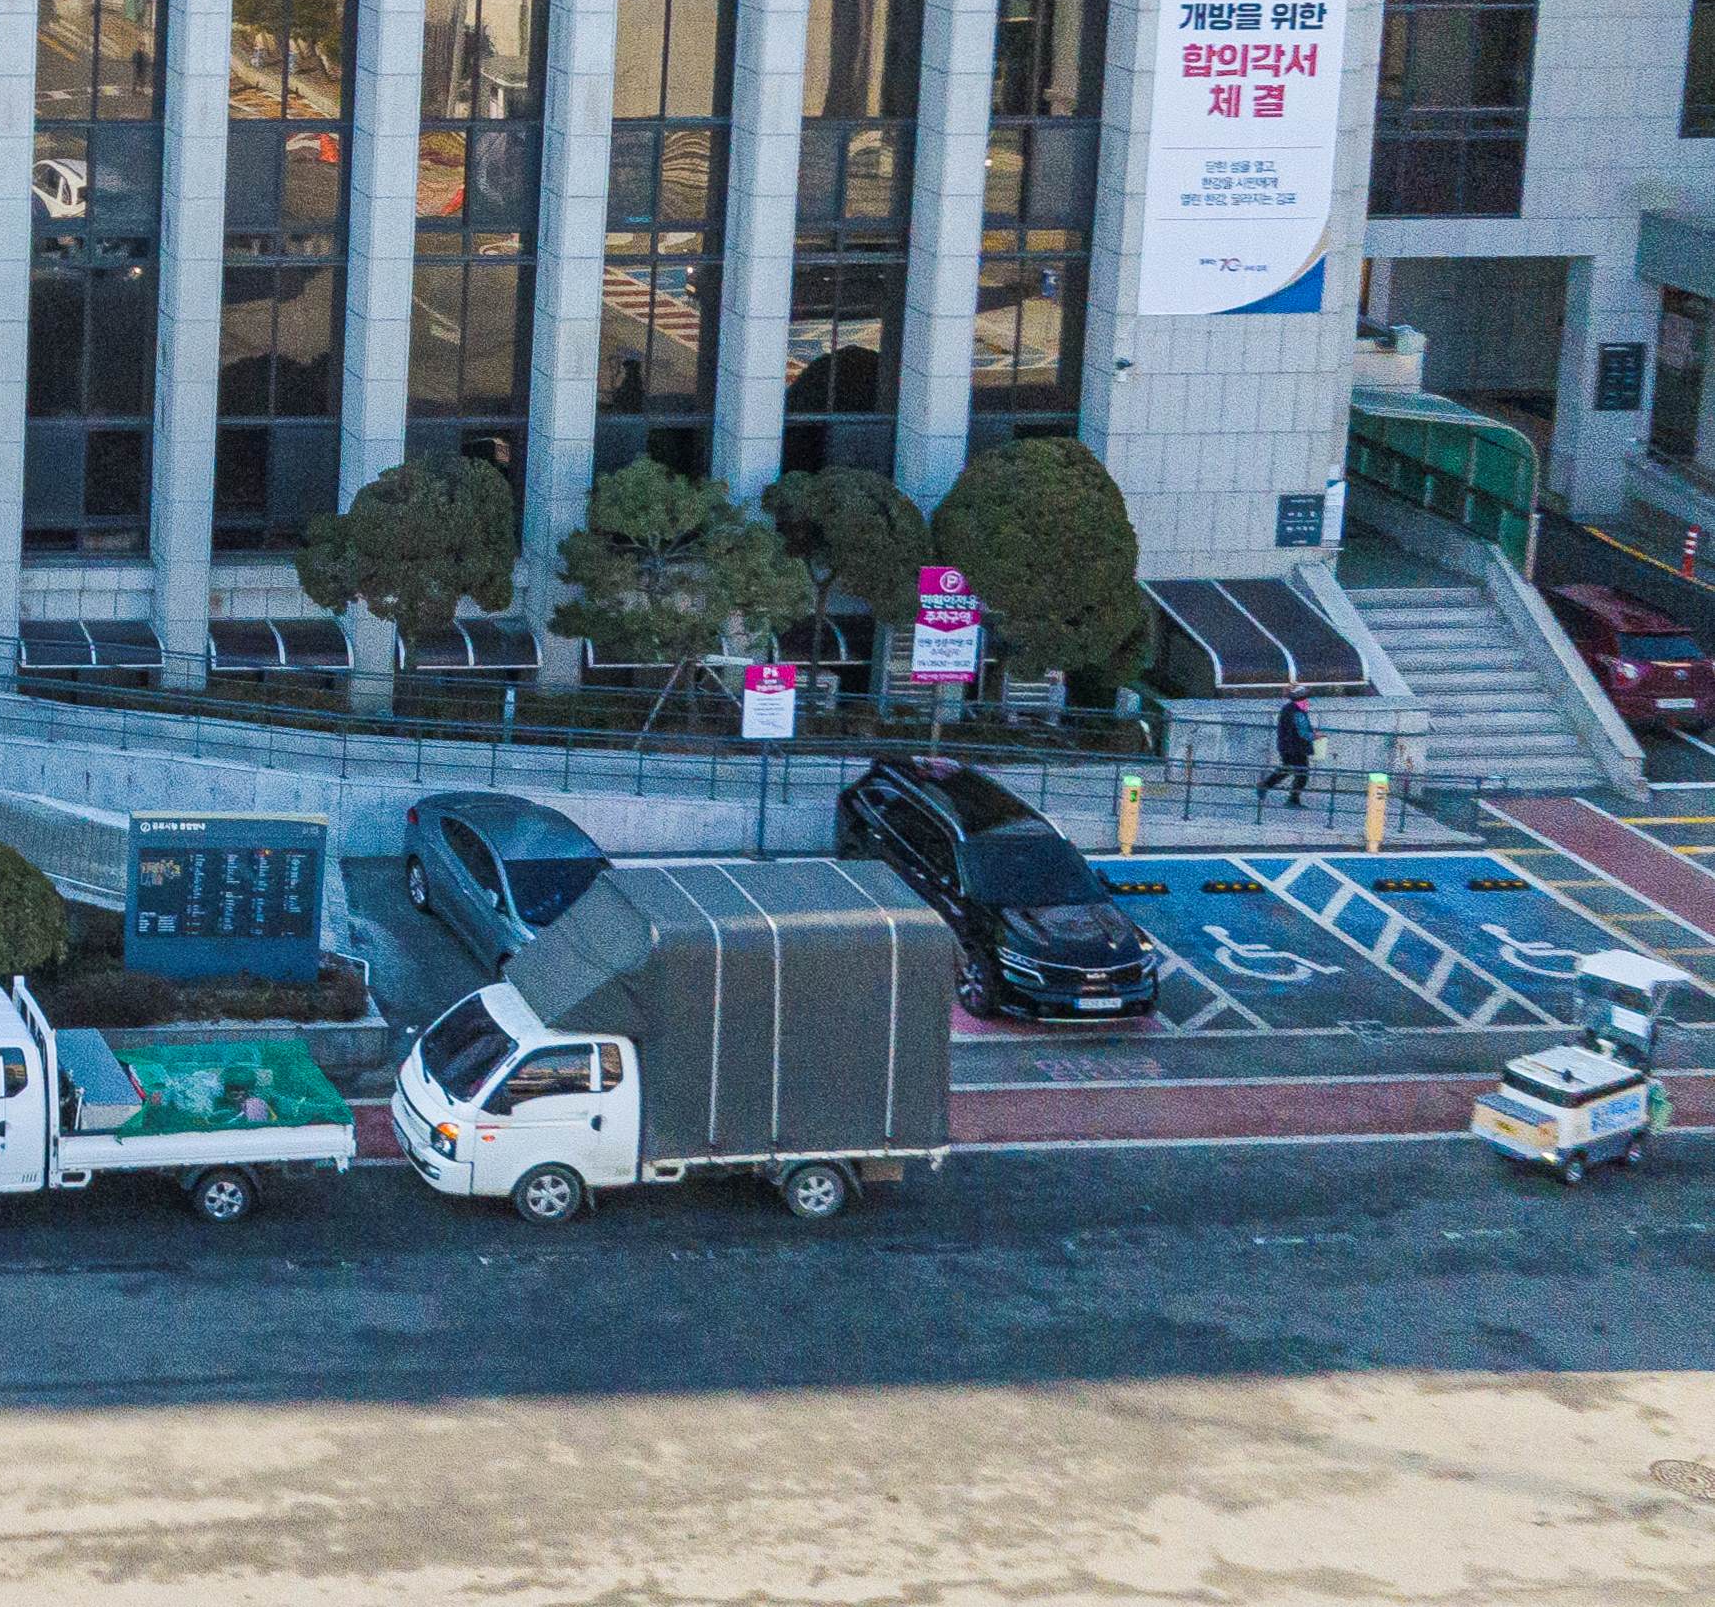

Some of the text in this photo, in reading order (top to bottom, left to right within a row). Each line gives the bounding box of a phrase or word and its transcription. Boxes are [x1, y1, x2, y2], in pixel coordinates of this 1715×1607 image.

[1178, 2, 1327, 30] 개방을 위한
[1182, 44, 1318, 78] 합의각서
